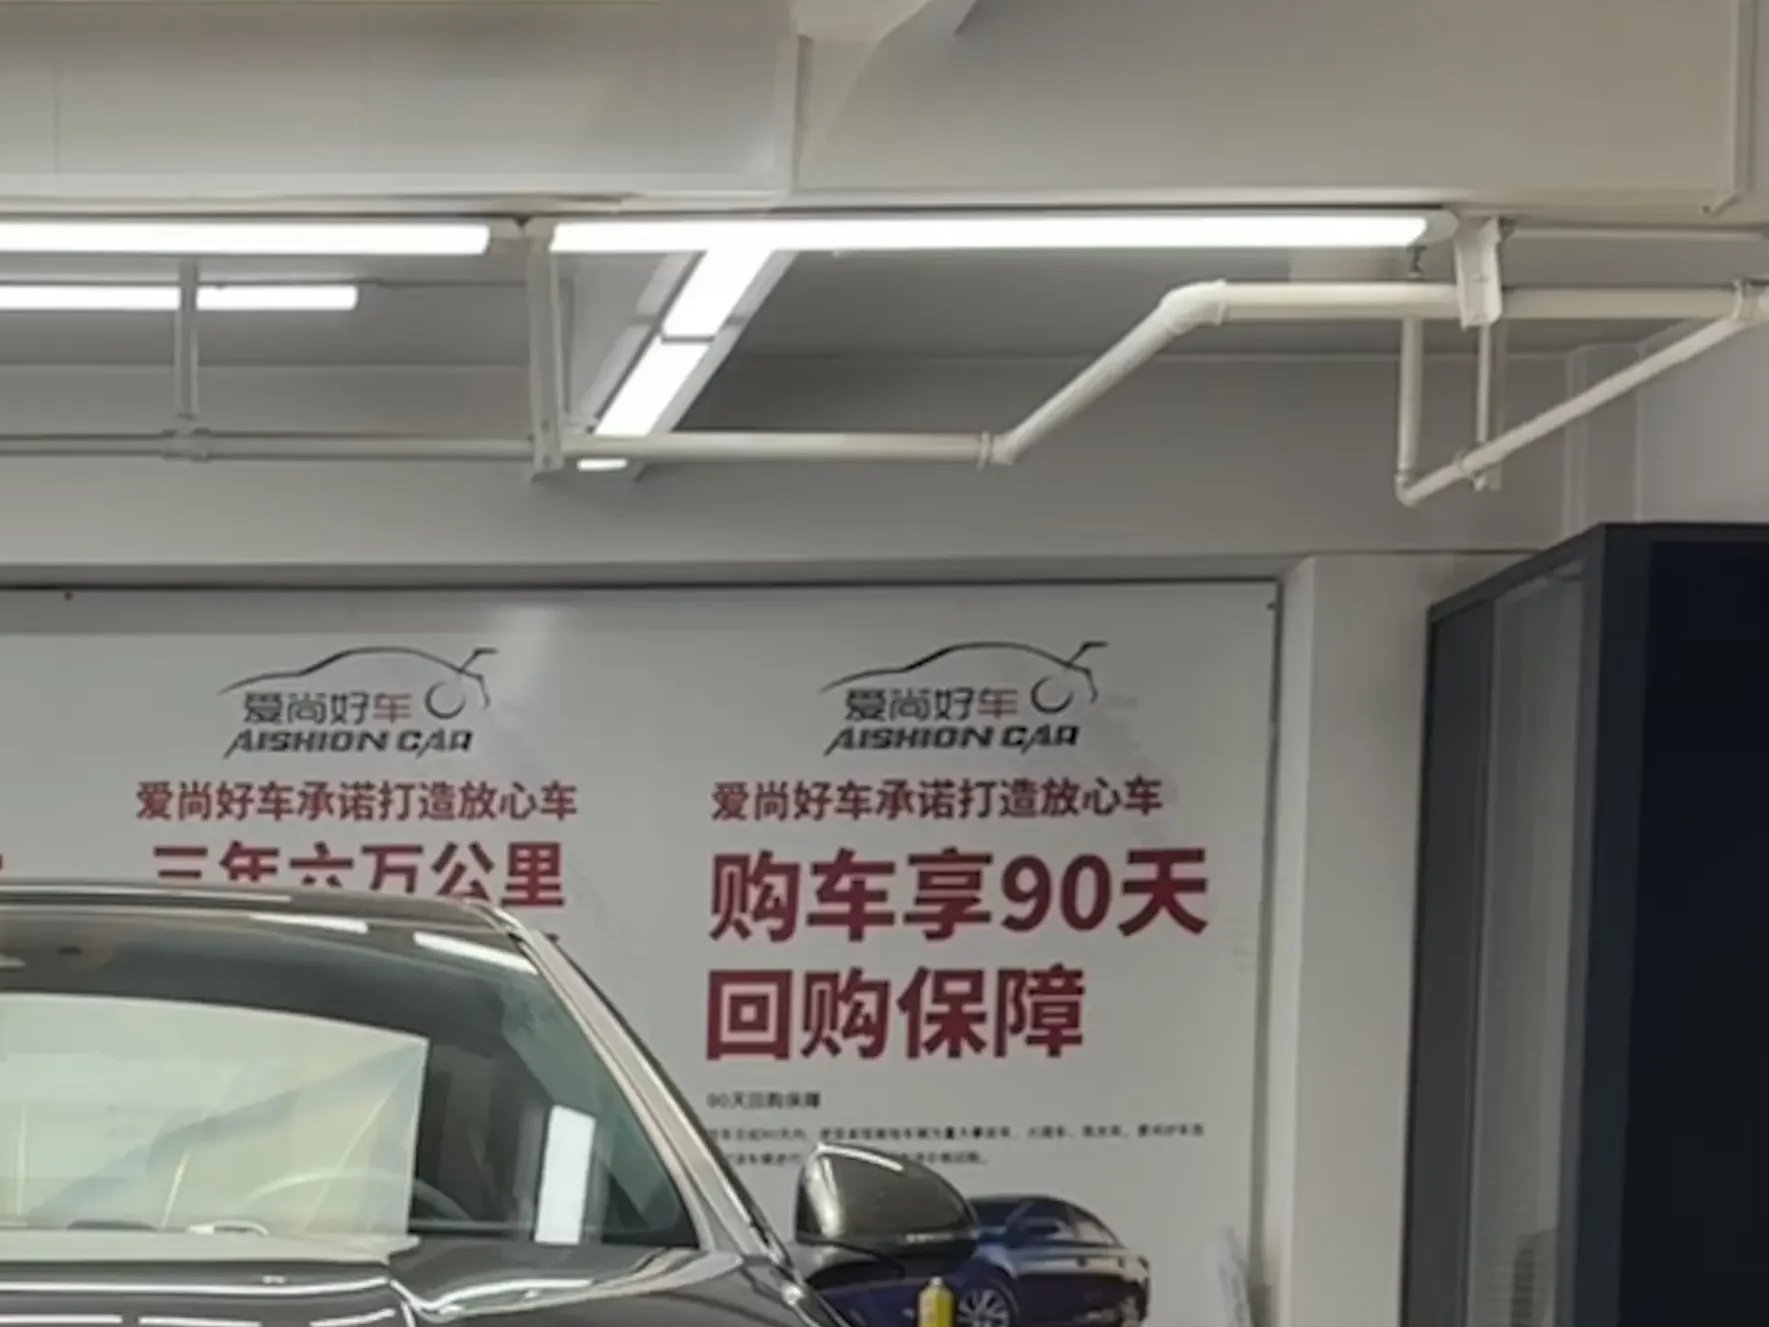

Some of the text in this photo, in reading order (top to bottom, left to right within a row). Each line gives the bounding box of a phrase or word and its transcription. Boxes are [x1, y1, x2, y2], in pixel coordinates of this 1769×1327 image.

[244, 692, 410, 725] 爱尚好车
[846, 687, 1017, 721] 爱尚好车
[224, 729, 473, 758] AISHION CAR
[824, 723, 1080, 756] AISHION CAR
[136, 780, 577, 822] 爱尚好车承诺打造放心车
[711, 774, 1164, 821] 爱尚好车承诺打造放心车
[708, 846, 1209, 943] 购车享90天
[706, 962, 1086, 1061] 回购保障
